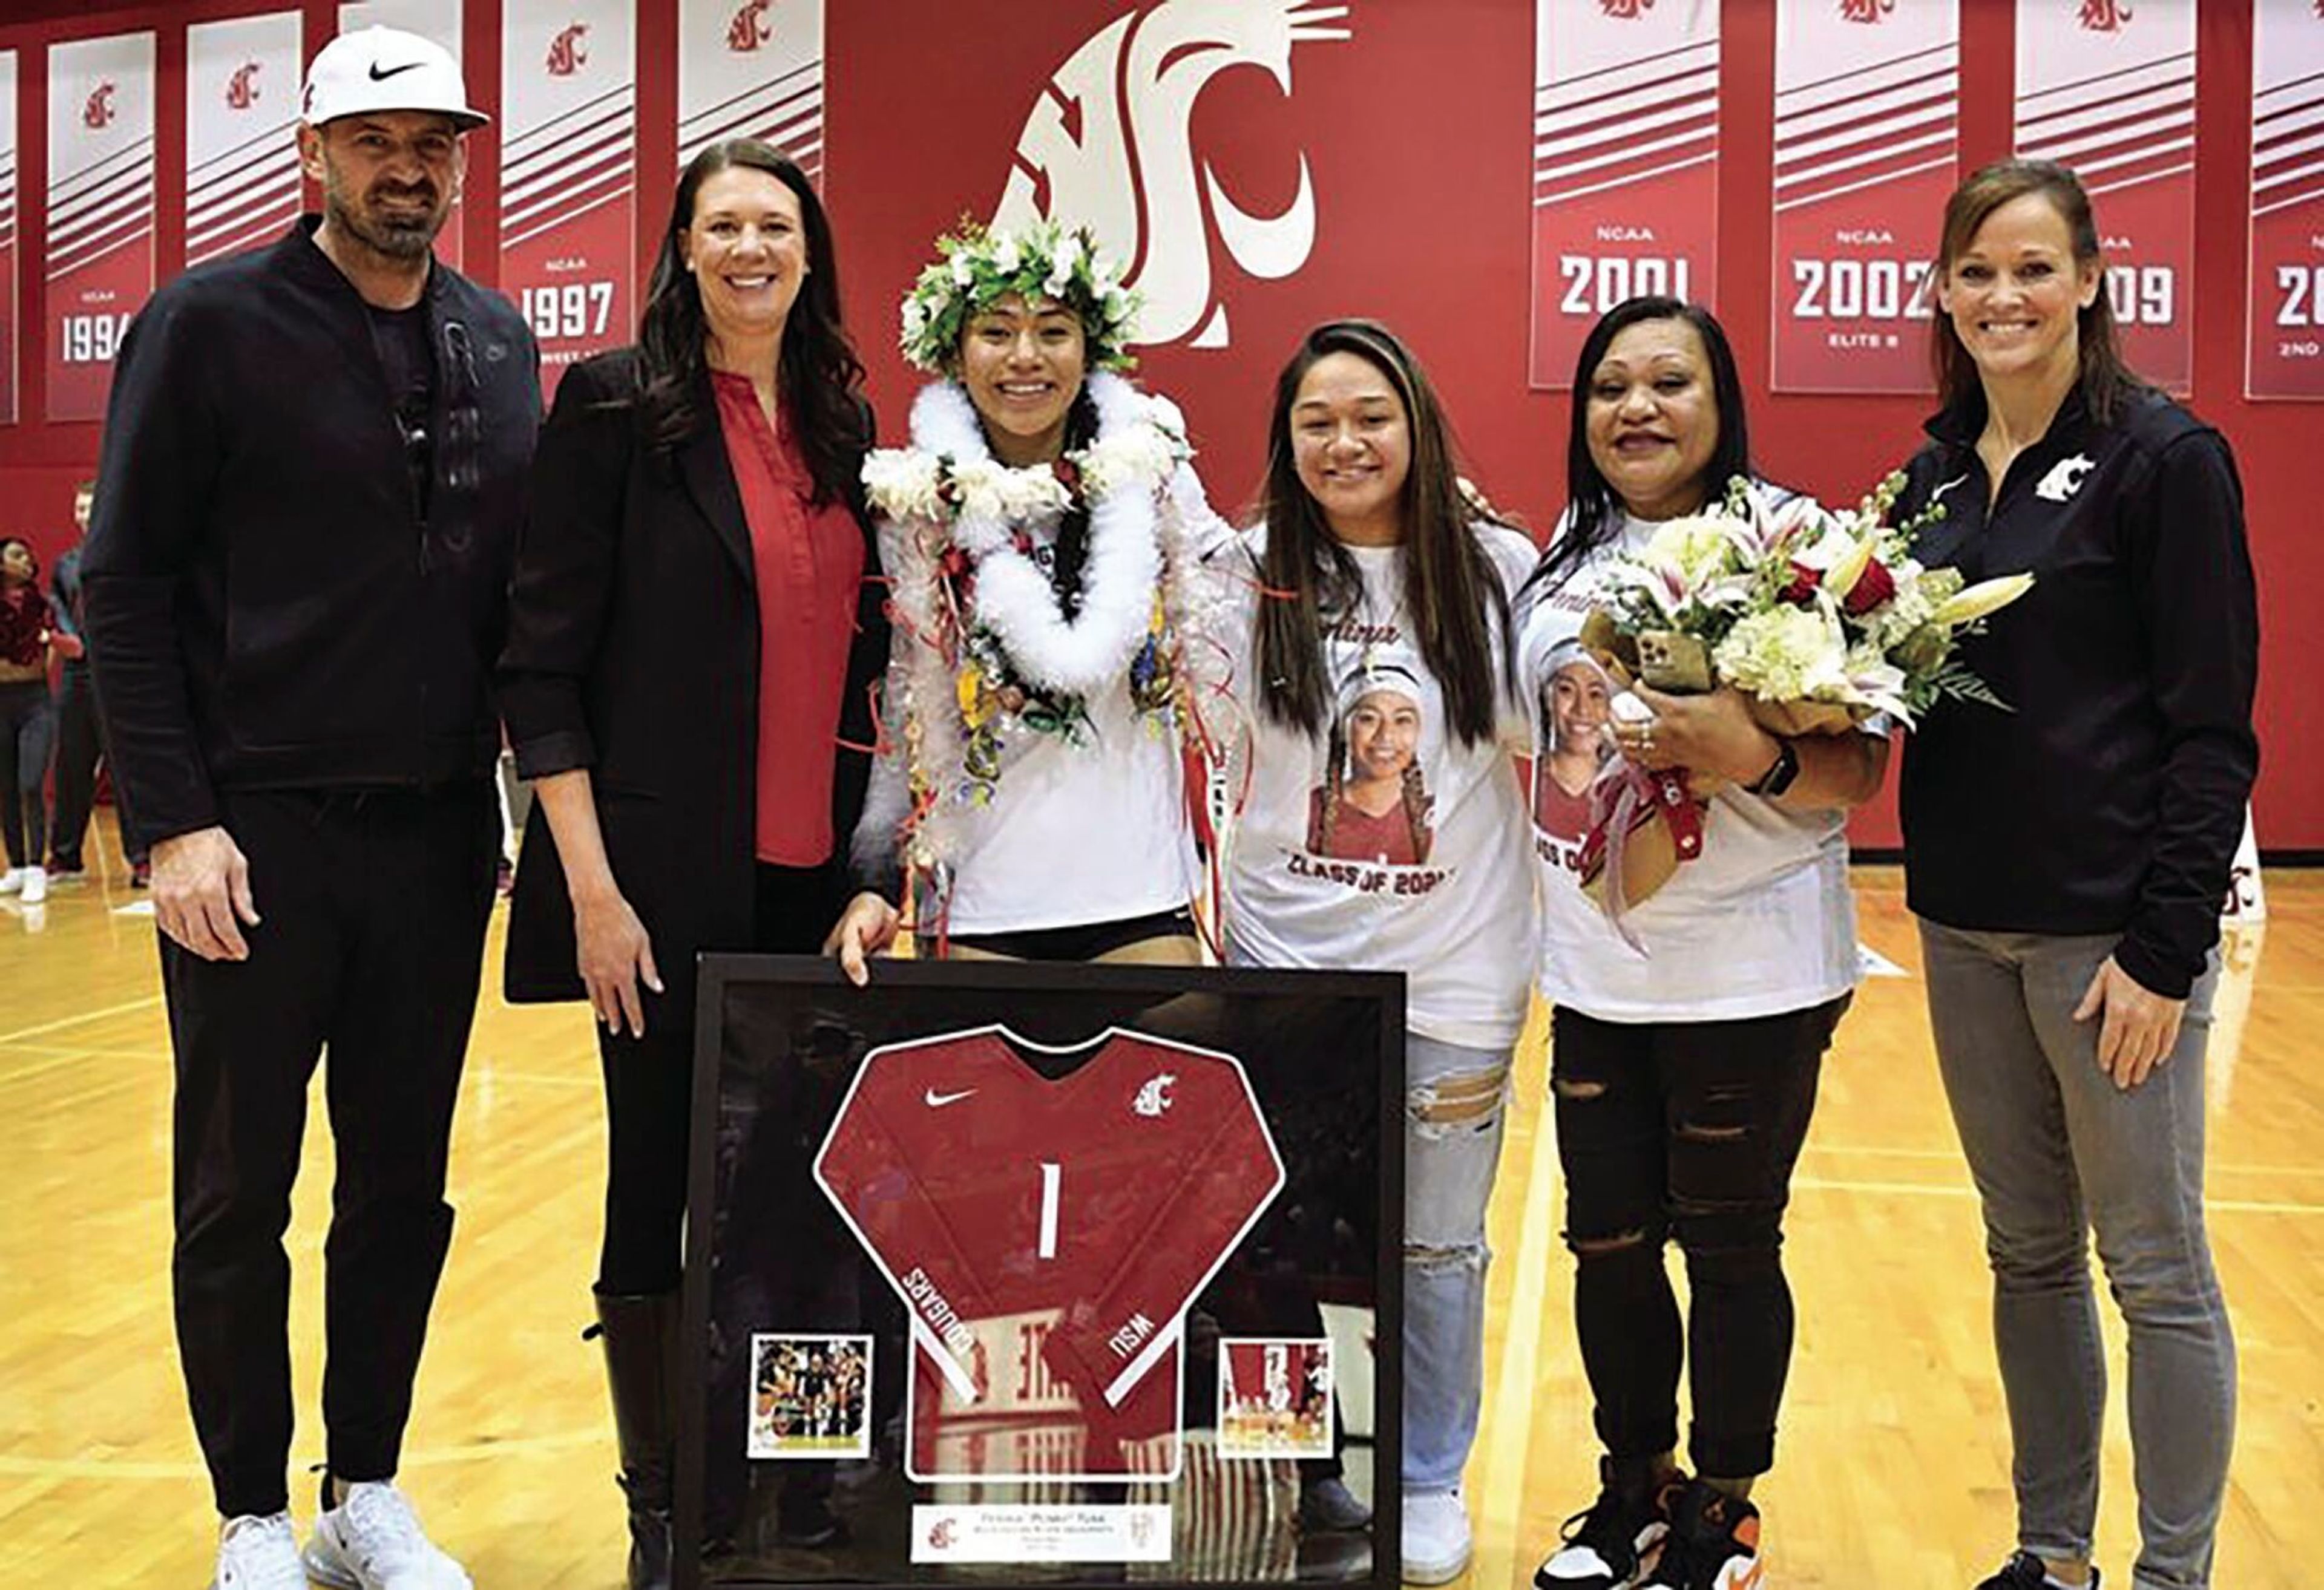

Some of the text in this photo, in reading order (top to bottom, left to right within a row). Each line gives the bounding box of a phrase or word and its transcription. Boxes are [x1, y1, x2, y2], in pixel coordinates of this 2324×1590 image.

[1596, 226, 1653, 241] NCAA
[1836, 230, 1894, 244] NCAA
[522, 281, 613, 338] 1997
[1560, 255, 1689, 316] 2001
[1792, 258, 1934, 318] 2002
[2106, 266, 2173, 324] 09
[1829, 335, 1880, 347] ELITE
[2279, 343, 2320, 356] 2ND
[1039, 1163, 1060, 1258] 1
[902, 1268, 974, 1356] COUGARS
[1108, 1313, 1155, 1359] WSU
